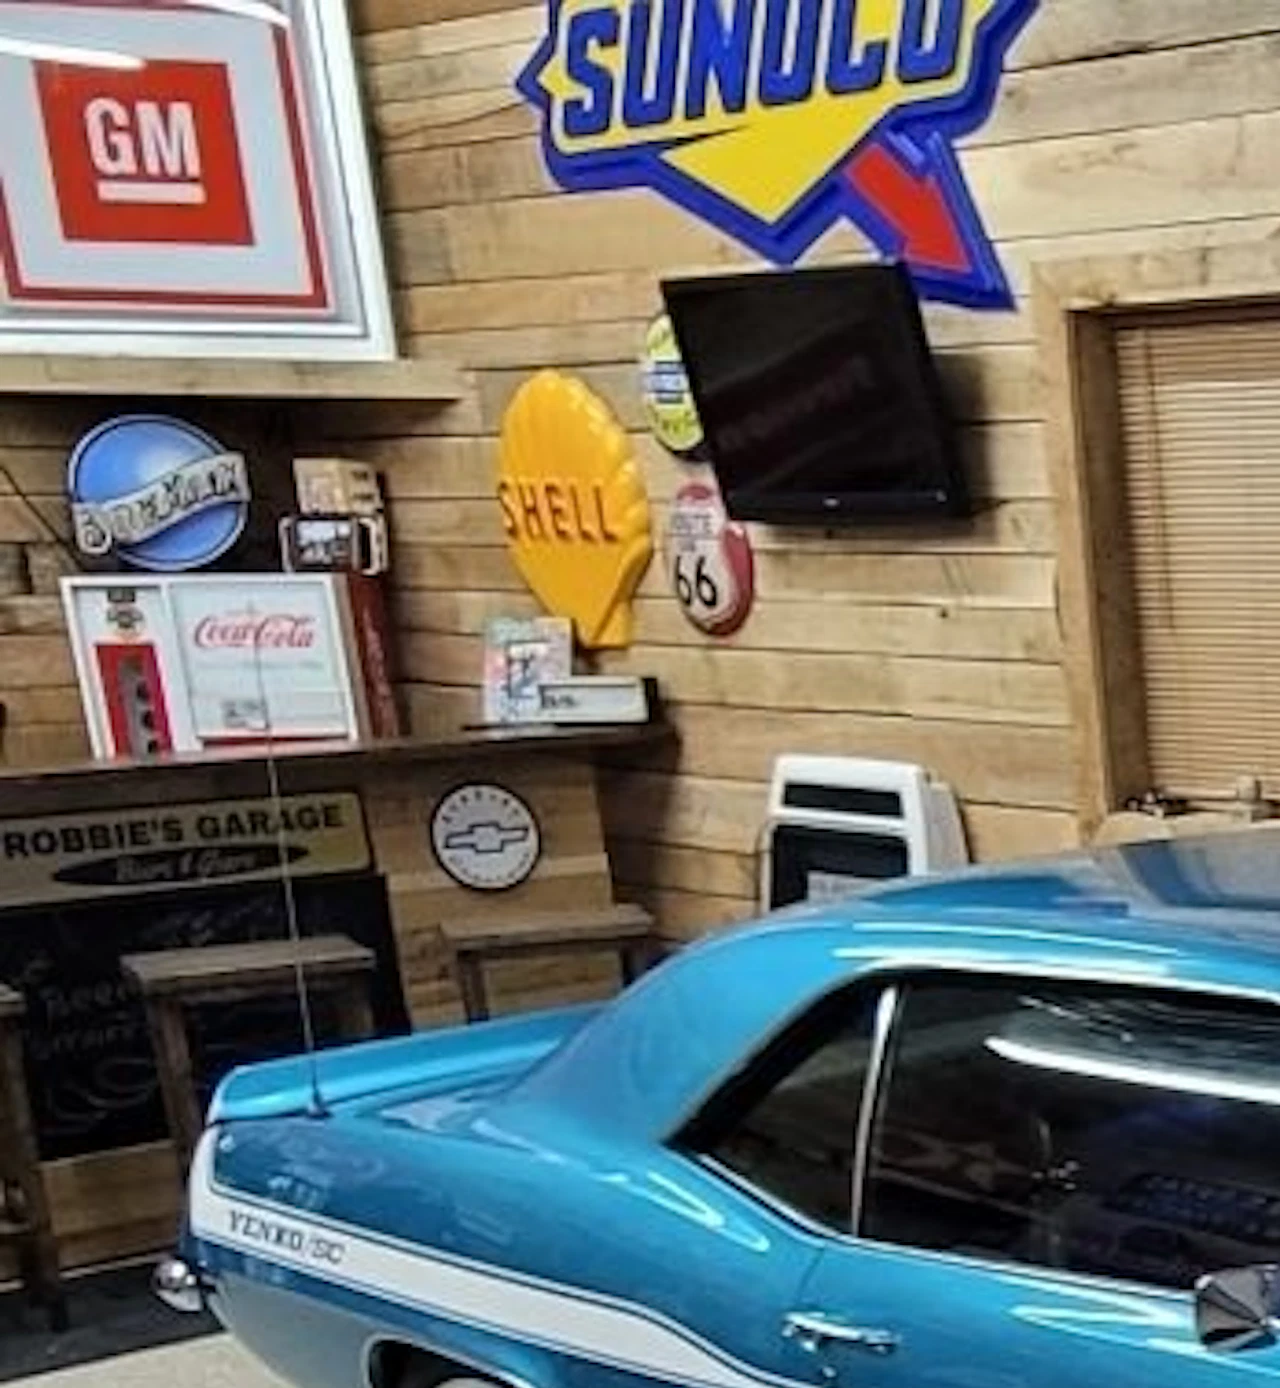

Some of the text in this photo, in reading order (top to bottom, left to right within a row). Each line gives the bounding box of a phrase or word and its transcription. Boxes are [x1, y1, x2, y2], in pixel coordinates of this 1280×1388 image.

[561, 0, 962, 136] SUNOCO
[84, 97, 201, 177] GM
[498, 481, 621, 543] SHELL
[675, 555, 718, 608] 66
[3, 802, 344, 859] ROBBIE'S GARAGE
[229, 1209, 347, 1264] YENKO/SC
